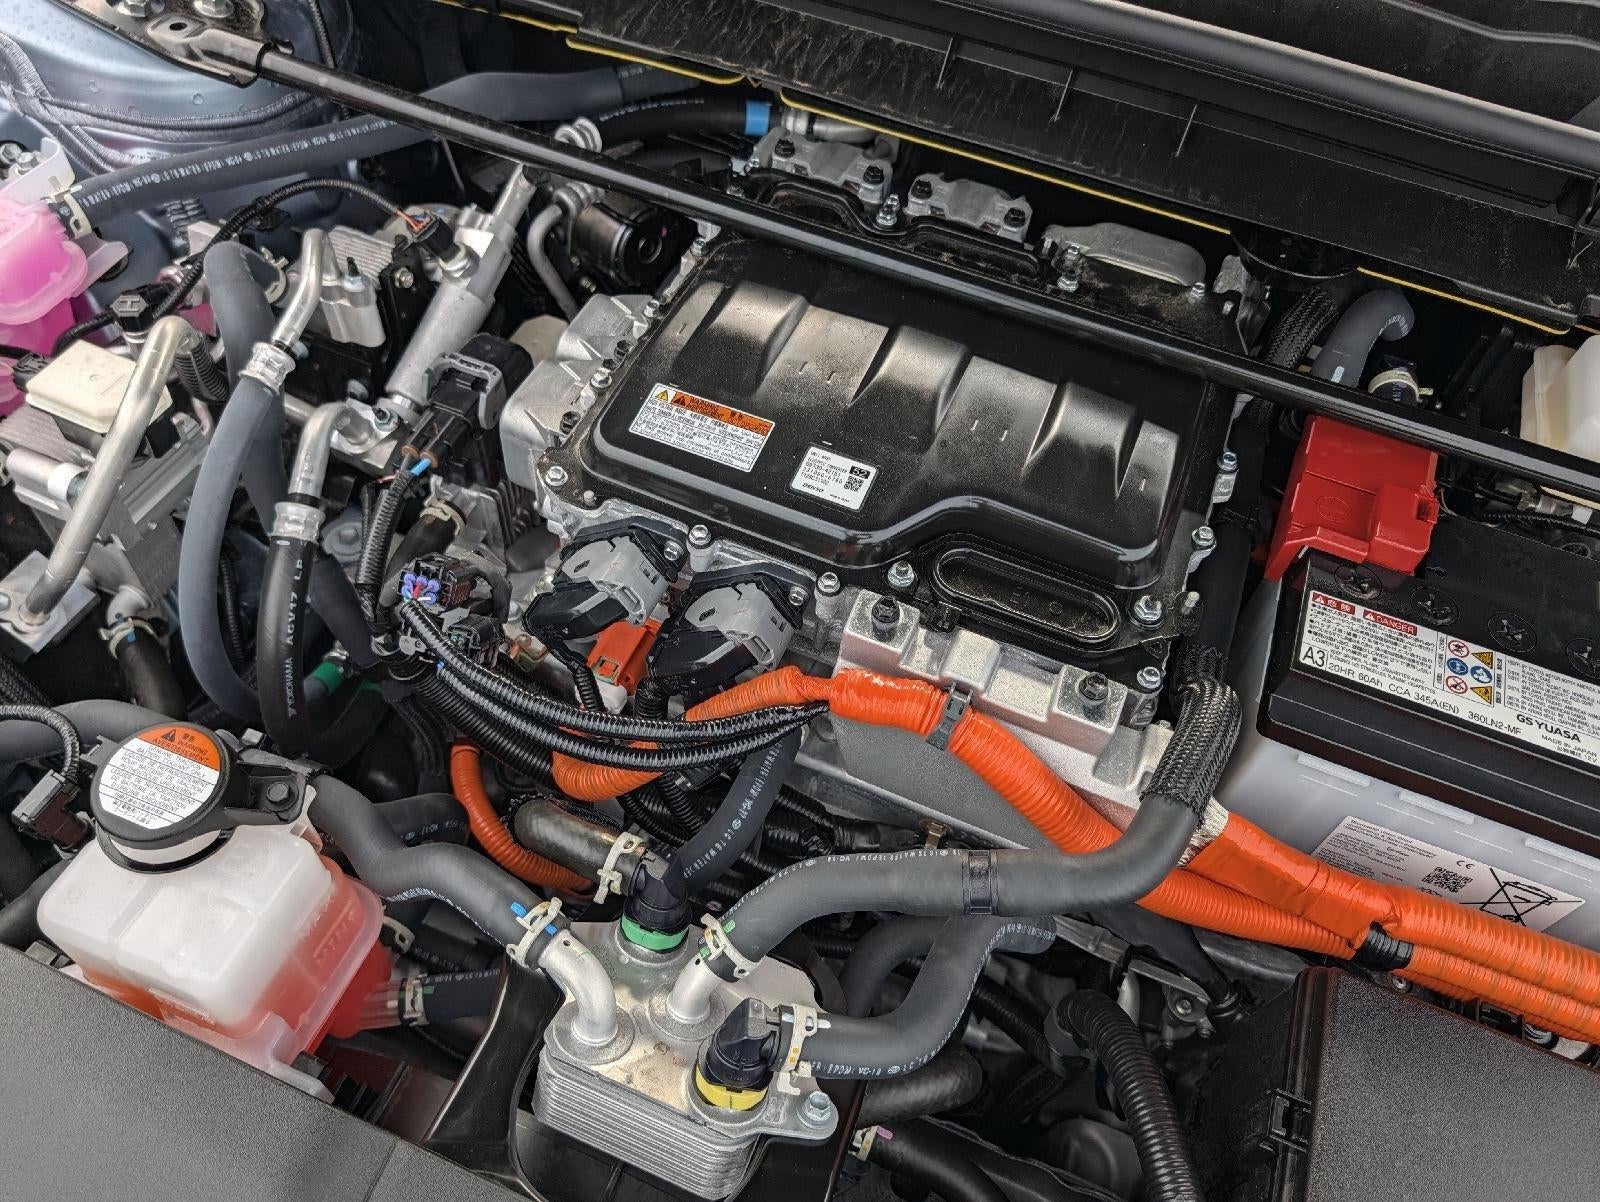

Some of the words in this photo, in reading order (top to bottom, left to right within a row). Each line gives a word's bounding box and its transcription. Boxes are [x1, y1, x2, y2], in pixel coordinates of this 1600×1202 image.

[852, 467, 868, 478] 52
[801, 482, 824, 493] DENSO
[1375, 614, 1414, 634] DANGER
[1302, 645, 1326, 668] A3
[1328, 662, 1355, 678] 20HR
[1387, 682, 1411, 697] CCA
[1534, 719, 1580, 744] YUASA
[152, 736, 209, 764] AVERTISSEMENT
[176, 738, 208, 756] WARNING
[1541, 733, 1561, 745] MADE
[1572, 745, 1596, 758] JAPAN
